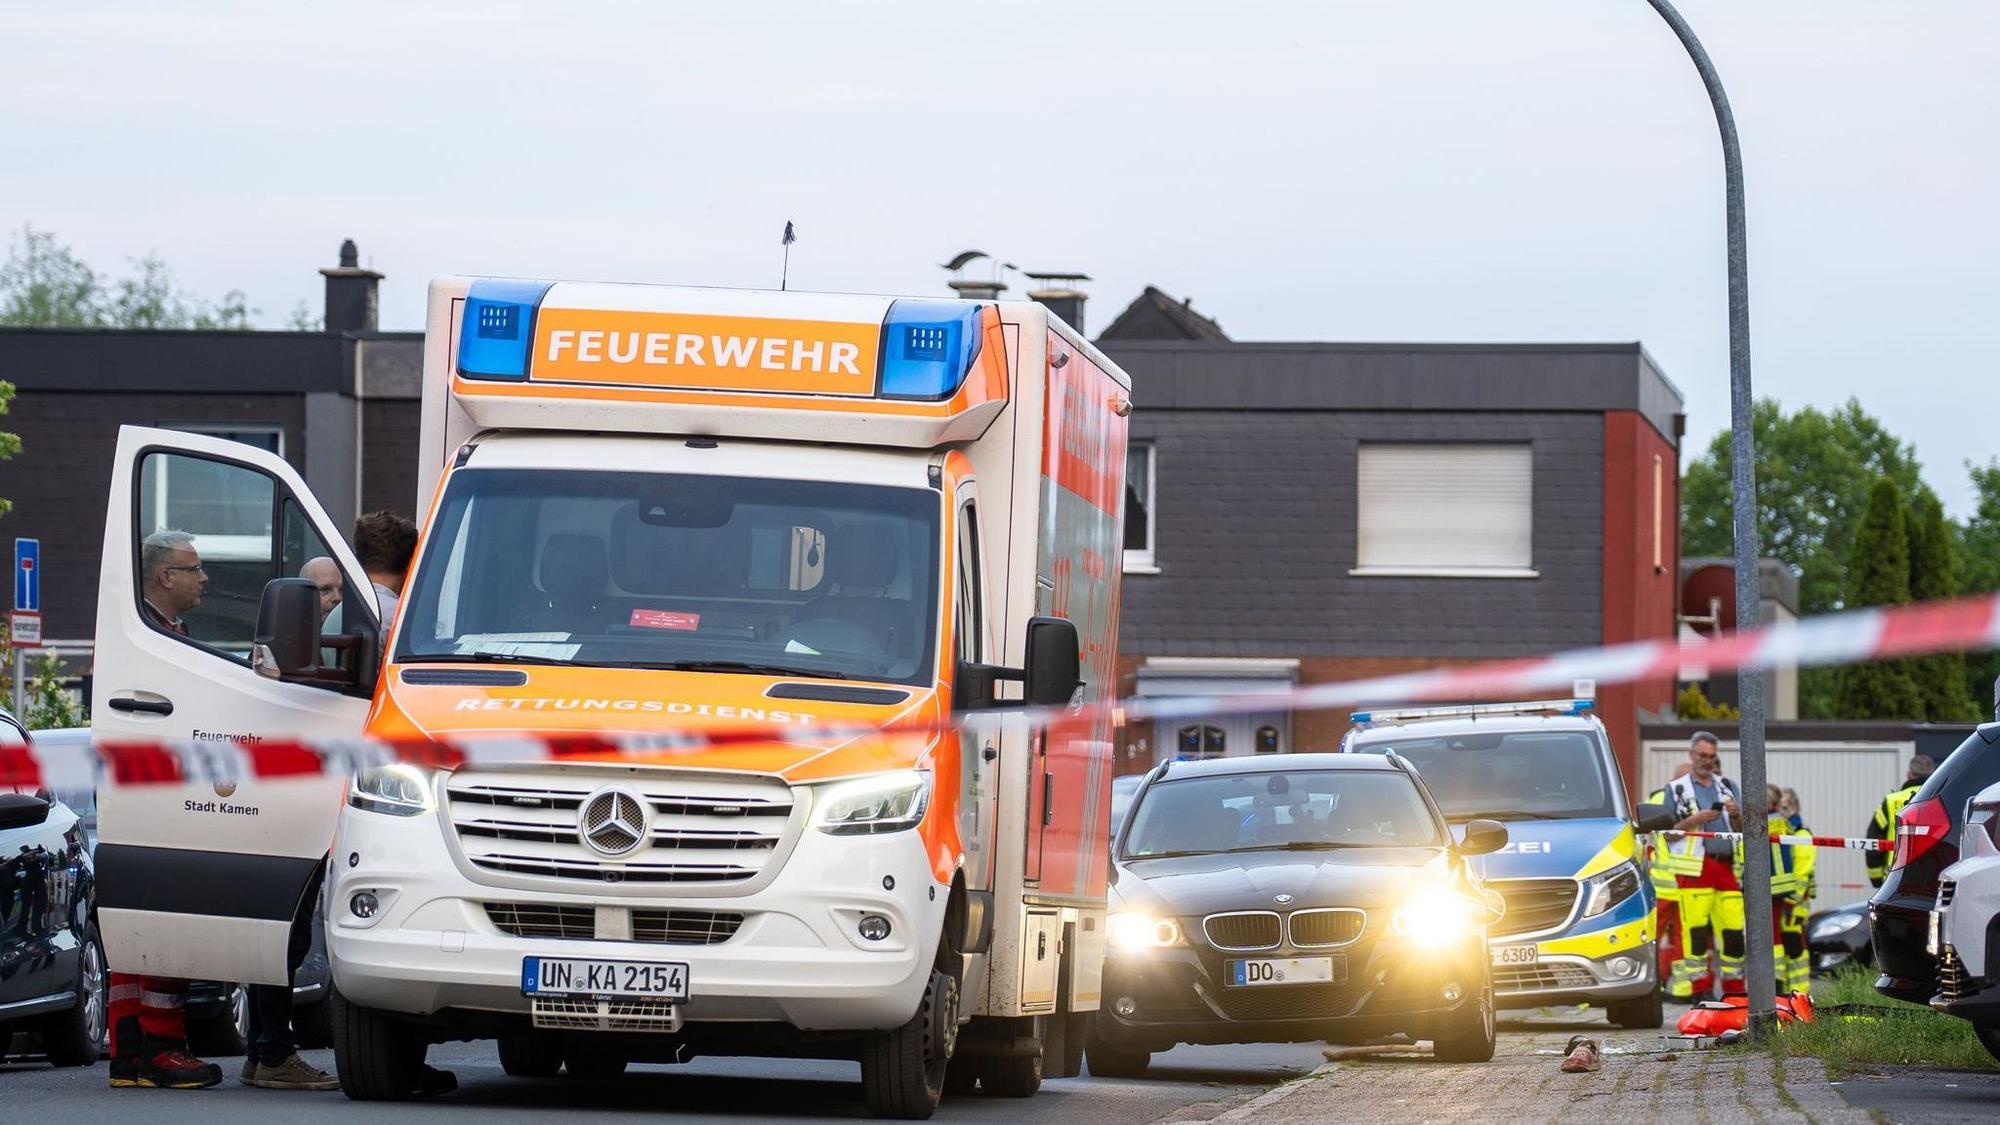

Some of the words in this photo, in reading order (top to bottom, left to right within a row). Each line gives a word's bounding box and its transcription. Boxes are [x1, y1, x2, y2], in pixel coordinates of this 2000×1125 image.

[548, 329, 861, 375] FEUERWEHR
[454, 698, 816, 725] RETTUNGSDIENST
[192, 729, 262, 744] Feuerwehr
[184, 800, 216, 813] Stadt
[219, 802, 259, 815] Kamen
[527, 978, 534, 986] D
[542, 962, 571, 988] UN
[587, 964, 616, 990] KA
[623, 966, 682, 993] 2154
[1247, 963, 1273, 982] DO
